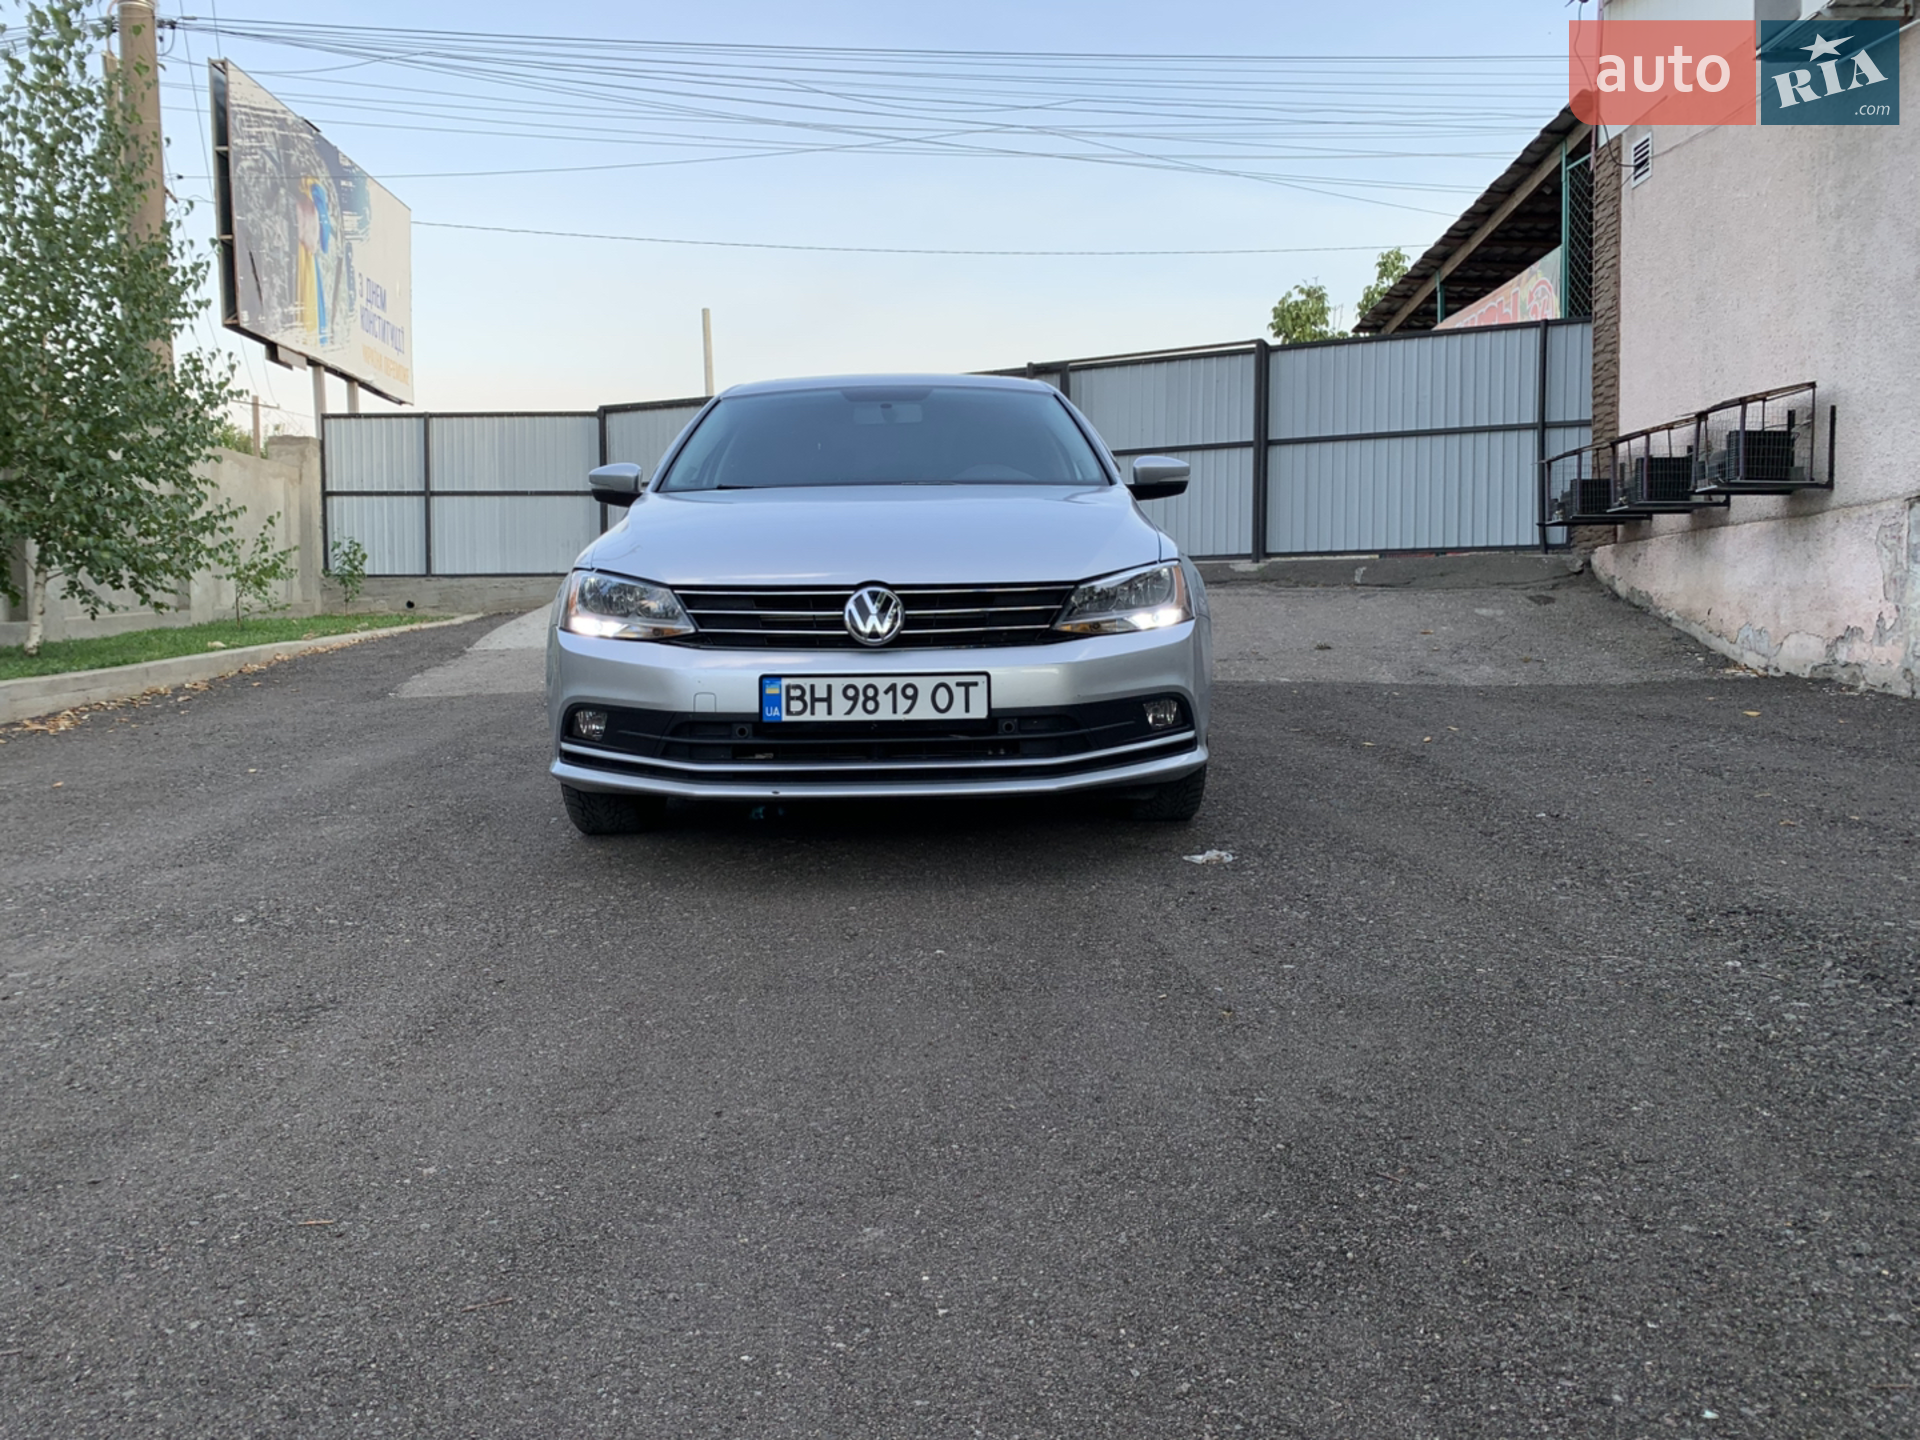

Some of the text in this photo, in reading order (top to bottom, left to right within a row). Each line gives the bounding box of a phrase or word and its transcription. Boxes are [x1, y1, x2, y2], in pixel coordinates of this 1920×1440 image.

[366, 277, 387, 313] ДНЕМ
[765, 681, 979, 717] UA BH 9819 OT
